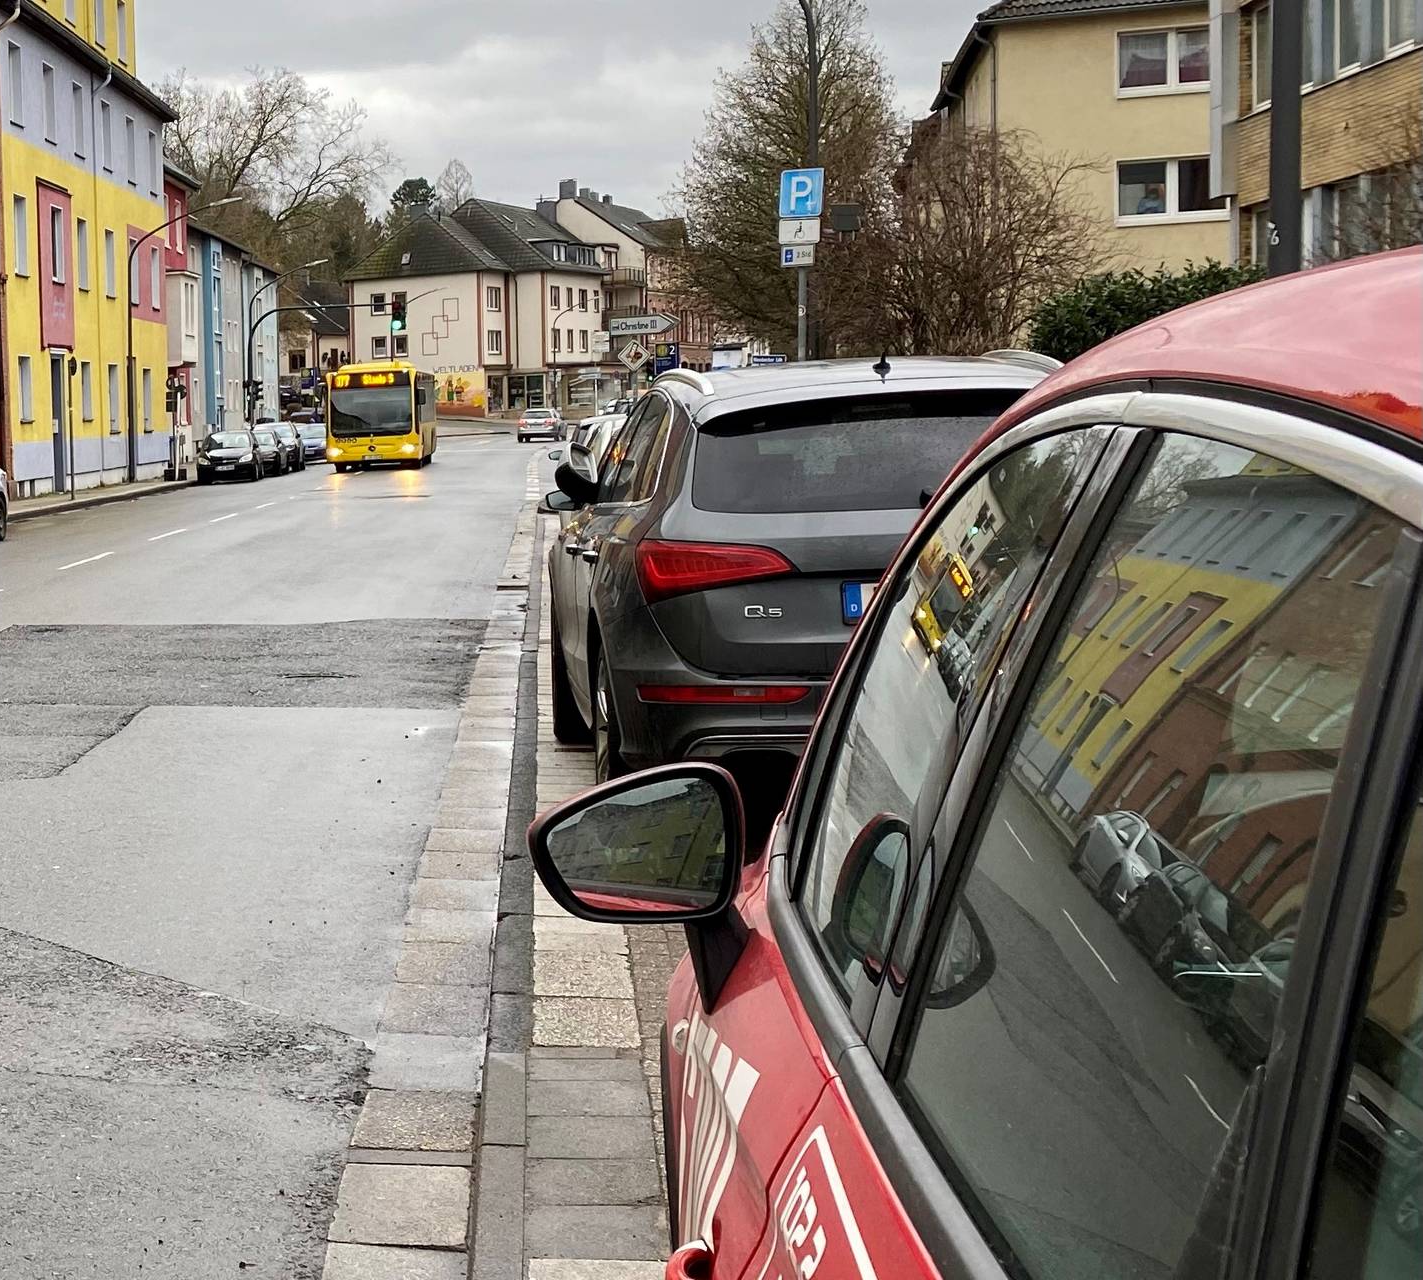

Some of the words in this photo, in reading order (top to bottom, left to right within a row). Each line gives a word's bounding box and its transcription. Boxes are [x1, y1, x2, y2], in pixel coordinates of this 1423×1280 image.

[790, 176, 812, 211] P
[1271, 230, 1280, 245] 6
[620, 321, 649, 331] Christine
[669, 345, 675, 355] 2
[433, 364, 480, 374] WELTLADEN
[744, 605, 783, 618] Q5
[850, 603, 858, 612] D
